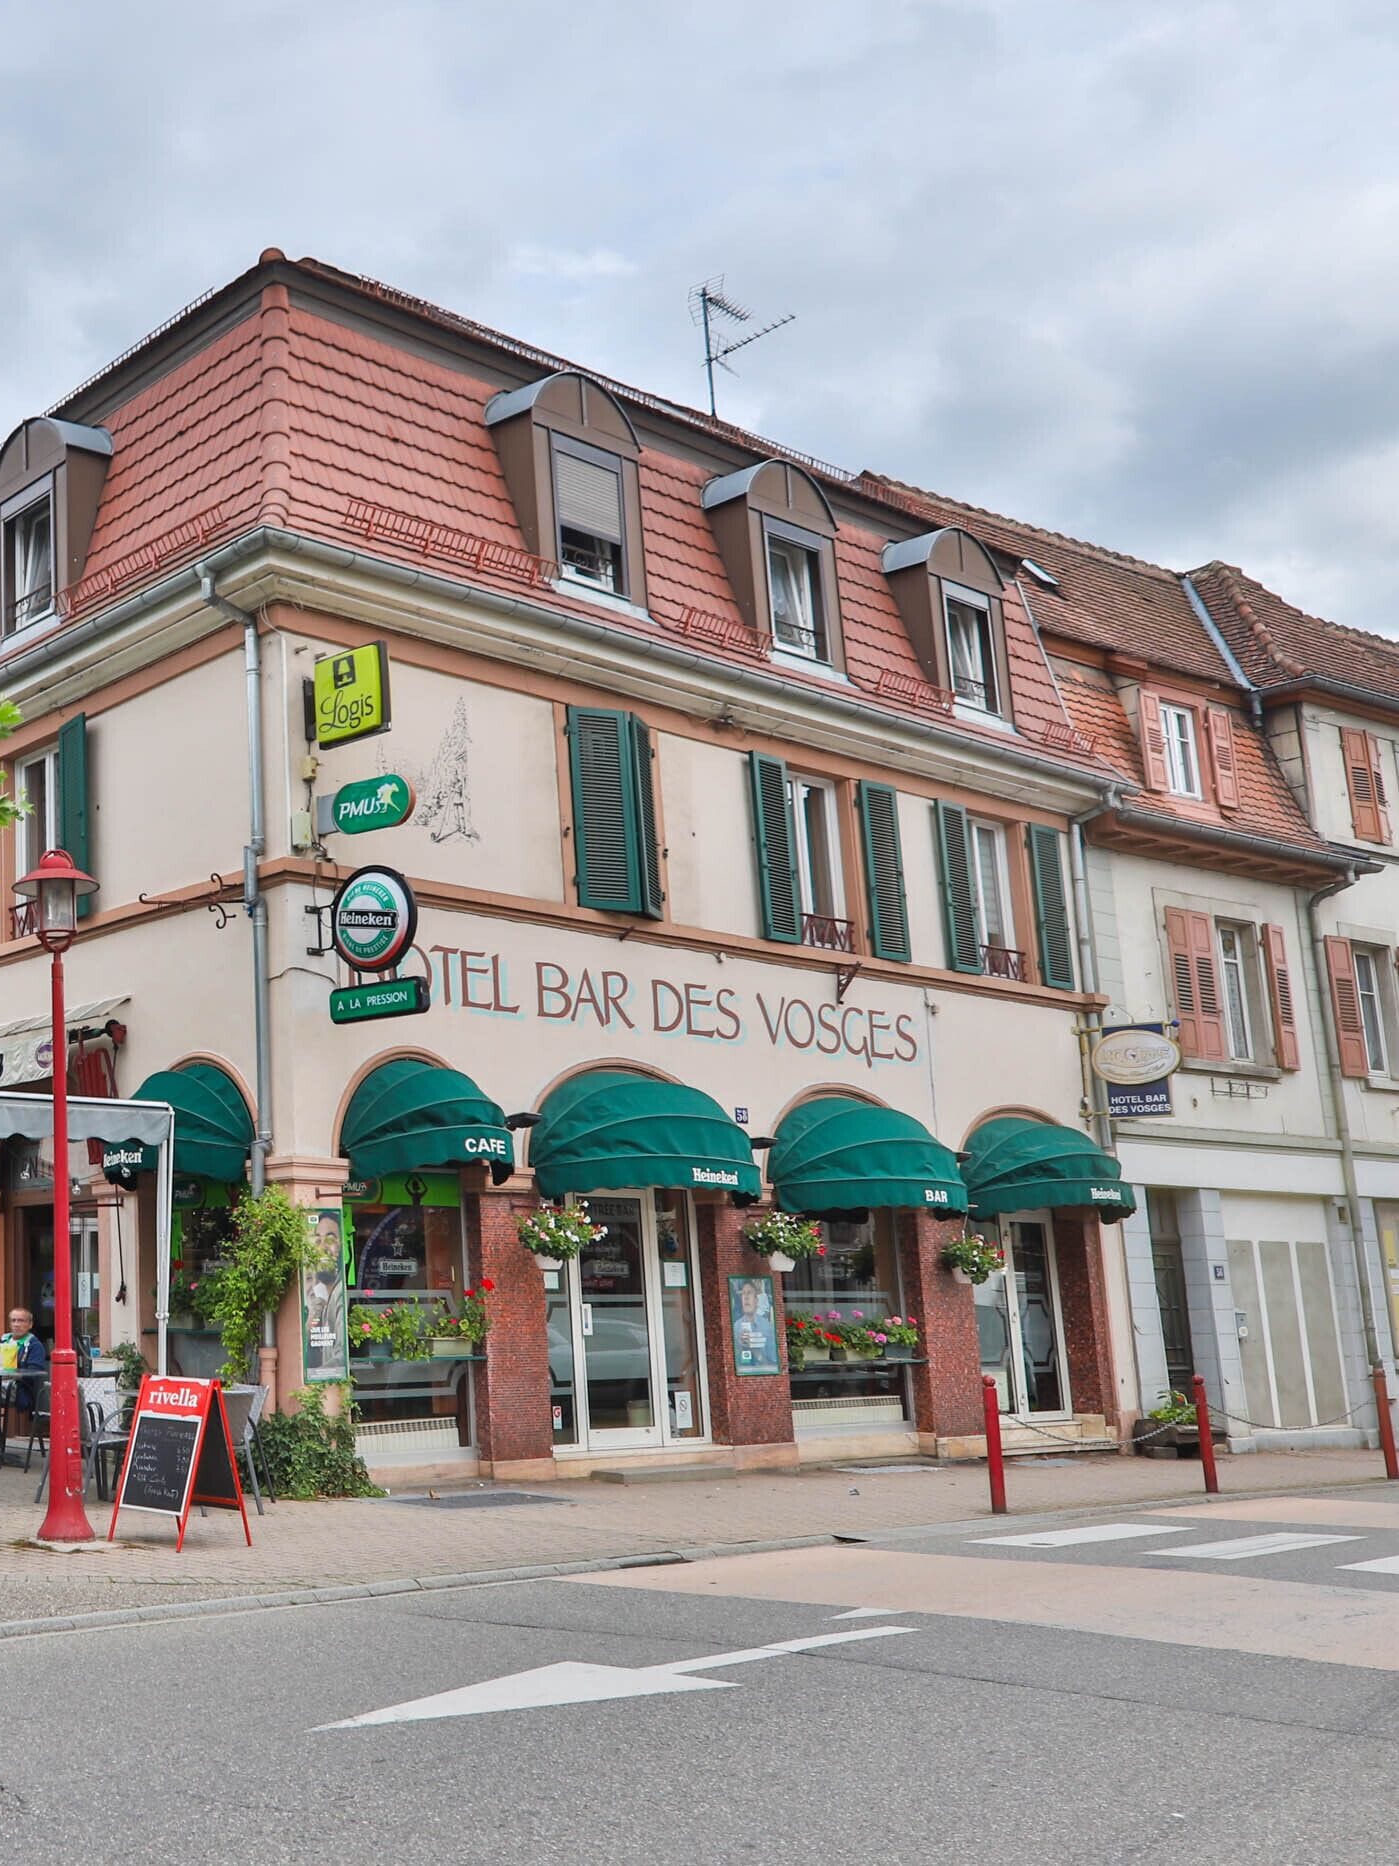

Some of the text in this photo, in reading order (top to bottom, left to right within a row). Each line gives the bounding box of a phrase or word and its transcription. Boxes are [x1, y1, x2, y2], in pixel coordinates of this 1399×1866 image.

[319, 690, 374, 733] Logis
[339, 799, 376, 820] PMU
[340, 911, 393, 926] Heineken
[338, 991, 408, 1010] A LA PRESSION
[535, 961, 635, 1029] BAR
[651, 979, 741, 1040] DES
[756, 992, 917, 1068] VOSGES
[1111, 1094, 1167, 1104] HOTEL BAR
[736, 1109, 748, 1122] 58
[1109, 1104, 1172, 1114] DES VOSGES
[465, 1138, 506, 1155] CAFE
[692, 1167, 739, 1185] Heineken
[924, 1189, 948, 1203] BAR
[382, 1261, 413, 1271] Heineken
[148, 1386, 198, 1407] rivella
